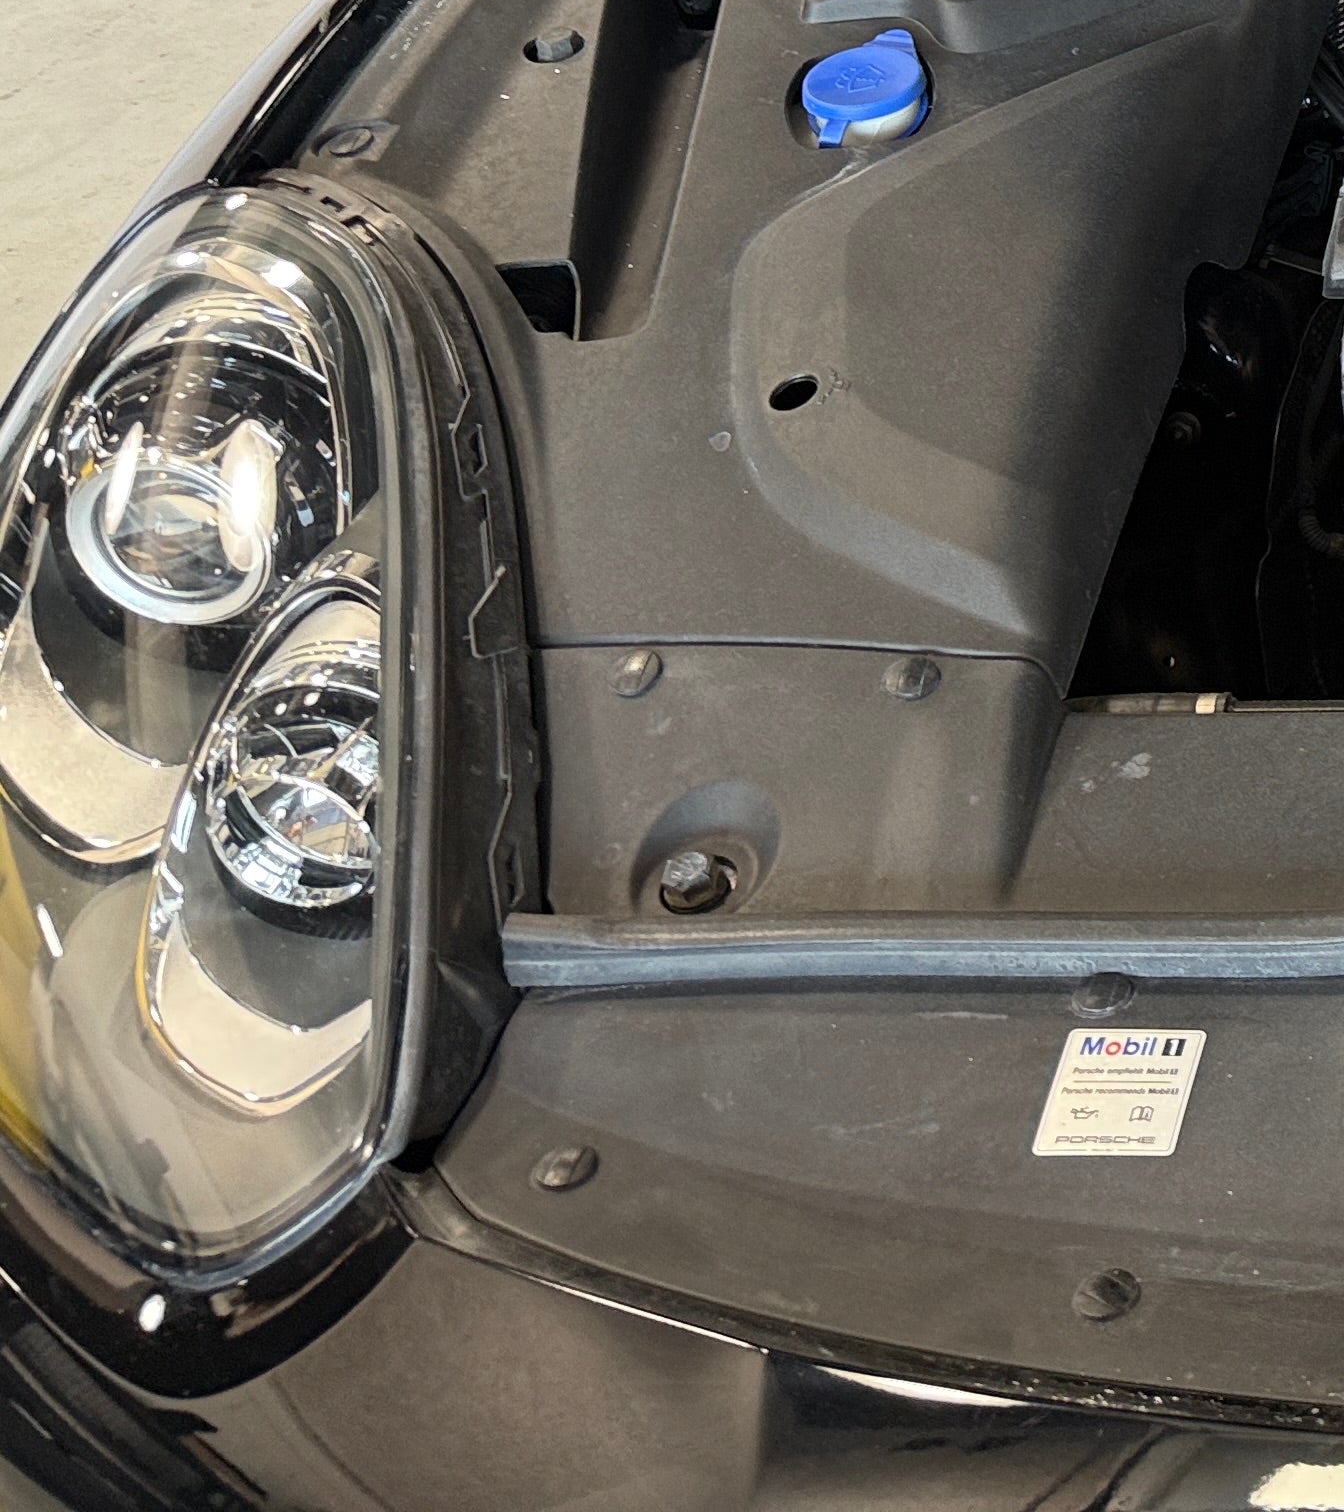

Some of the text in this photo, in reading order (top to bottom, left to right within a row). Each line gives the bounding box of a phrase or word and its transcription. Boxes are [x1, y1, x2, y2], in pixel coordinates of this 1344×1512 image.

[1080, 1037, 1184, 1056] Mobil 1
[1073, 1067, 1105, 1075] Porsche
[1062, 1087, 1093, 1095] Porsche
[1055, 1135, 1156, 1144] PORSCHE
